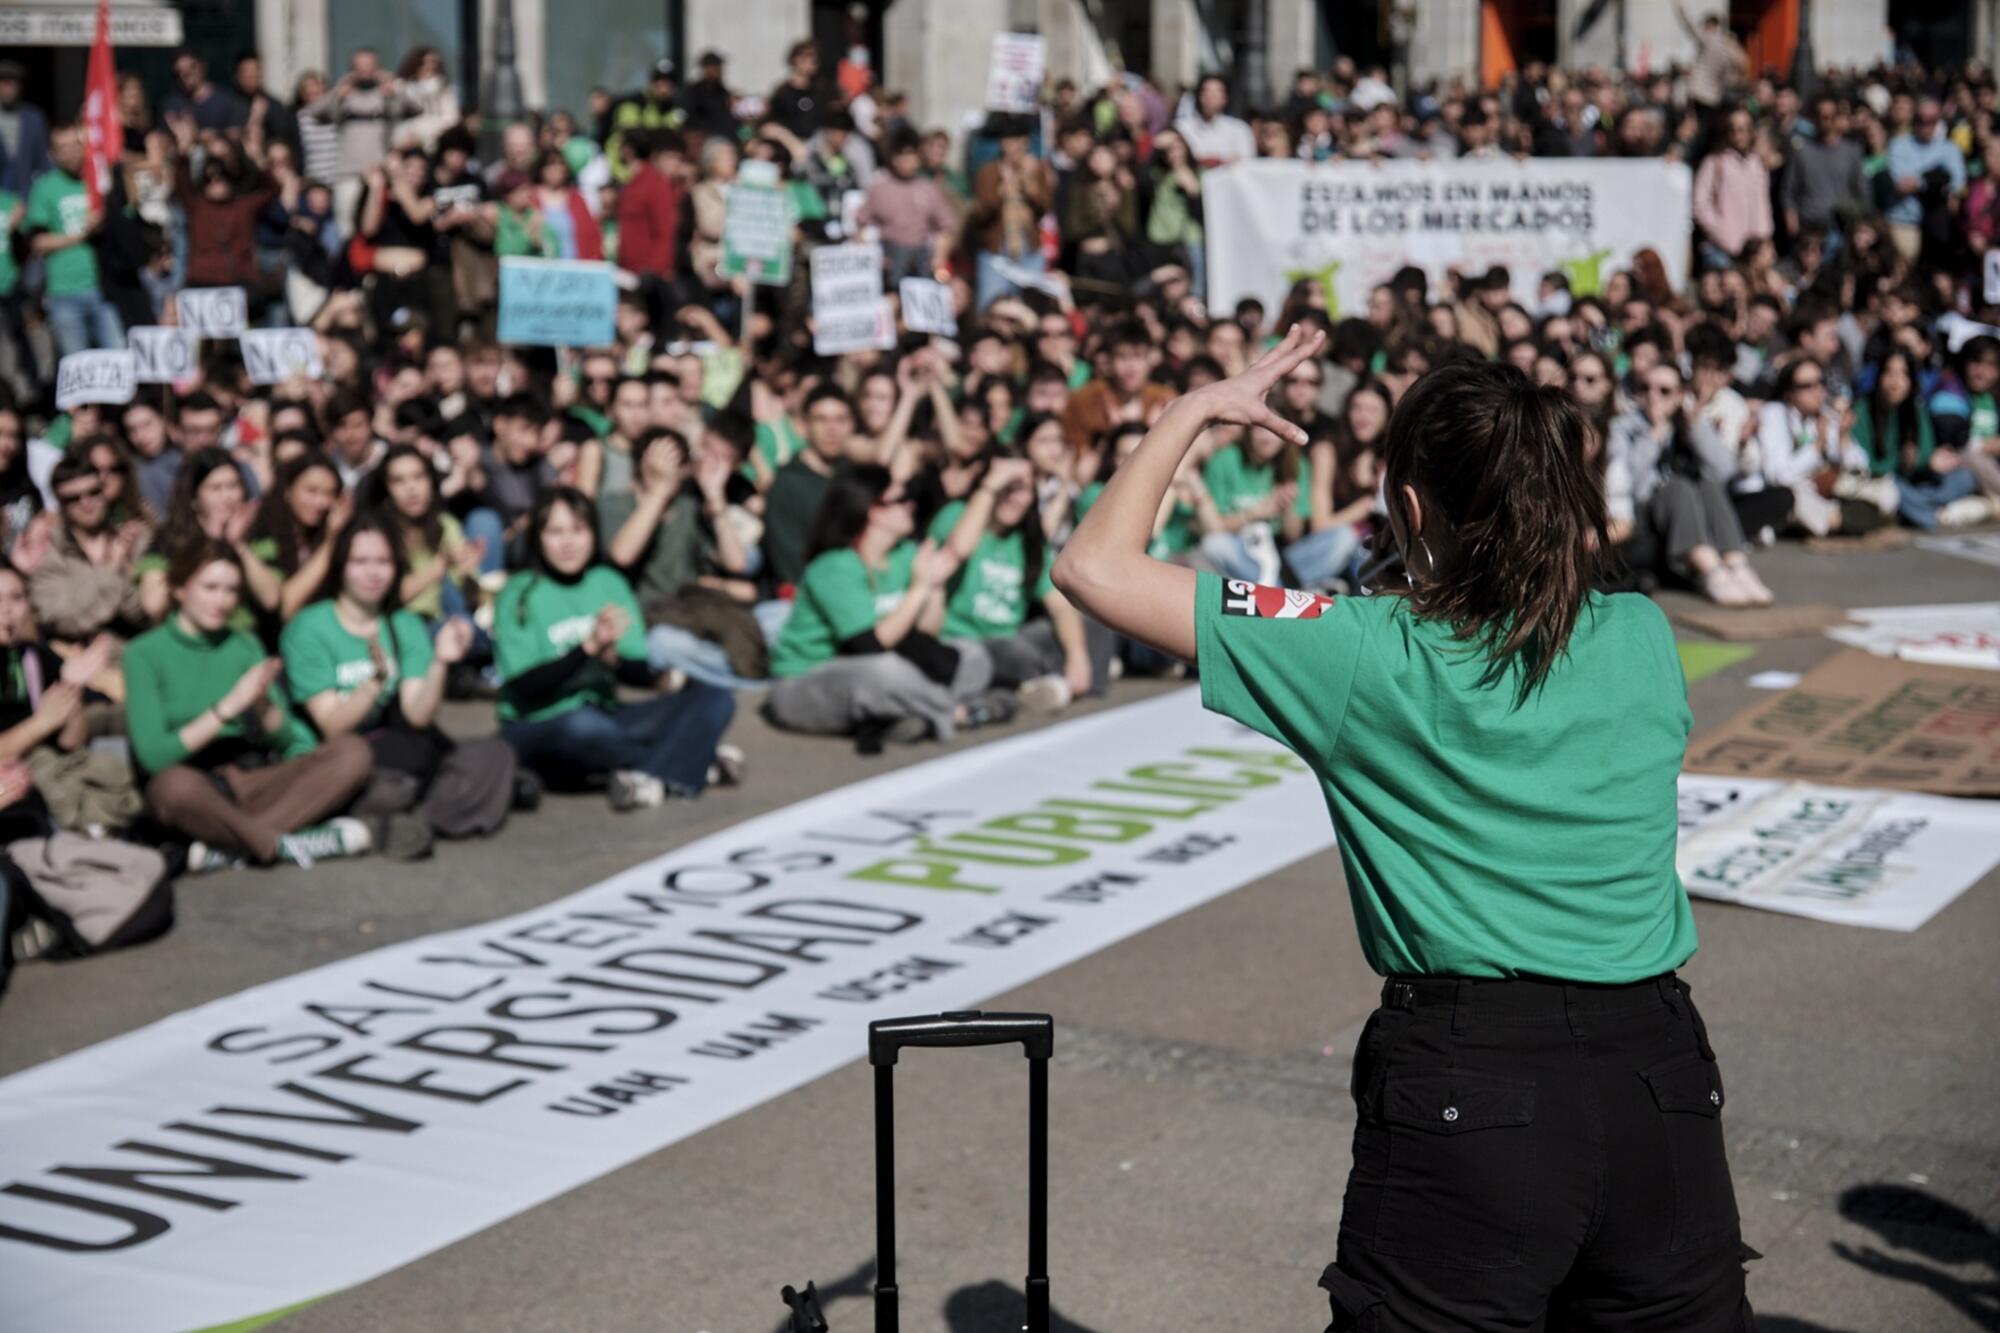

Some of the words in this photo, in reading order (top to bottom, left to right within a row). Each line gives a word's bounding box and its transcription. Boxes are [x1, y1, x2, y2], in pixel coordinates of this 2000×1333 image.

[1304, 181, 1432, 201] ESTAMOS
[1447, 181, 1477, 201] EN
[1491, 181, 1592, 201] MANOS
[1304, 208, 1338, 233] DE
[1352, 208, 1406, 233] LOS
[1423, 208, 1594, 233] MERCADOS
[181, 289, 235, 331] NO
[131, 335, 186, 375] NO
[206, 846, 836, 1065] SALVEMOS
[802, 808, 974, 847] LA
[0, 898, 924, 1253] UNIVERSIDAD
[547, 1069, 691, 1119] UAH
[687, 1012, 825, 1061] UAM
